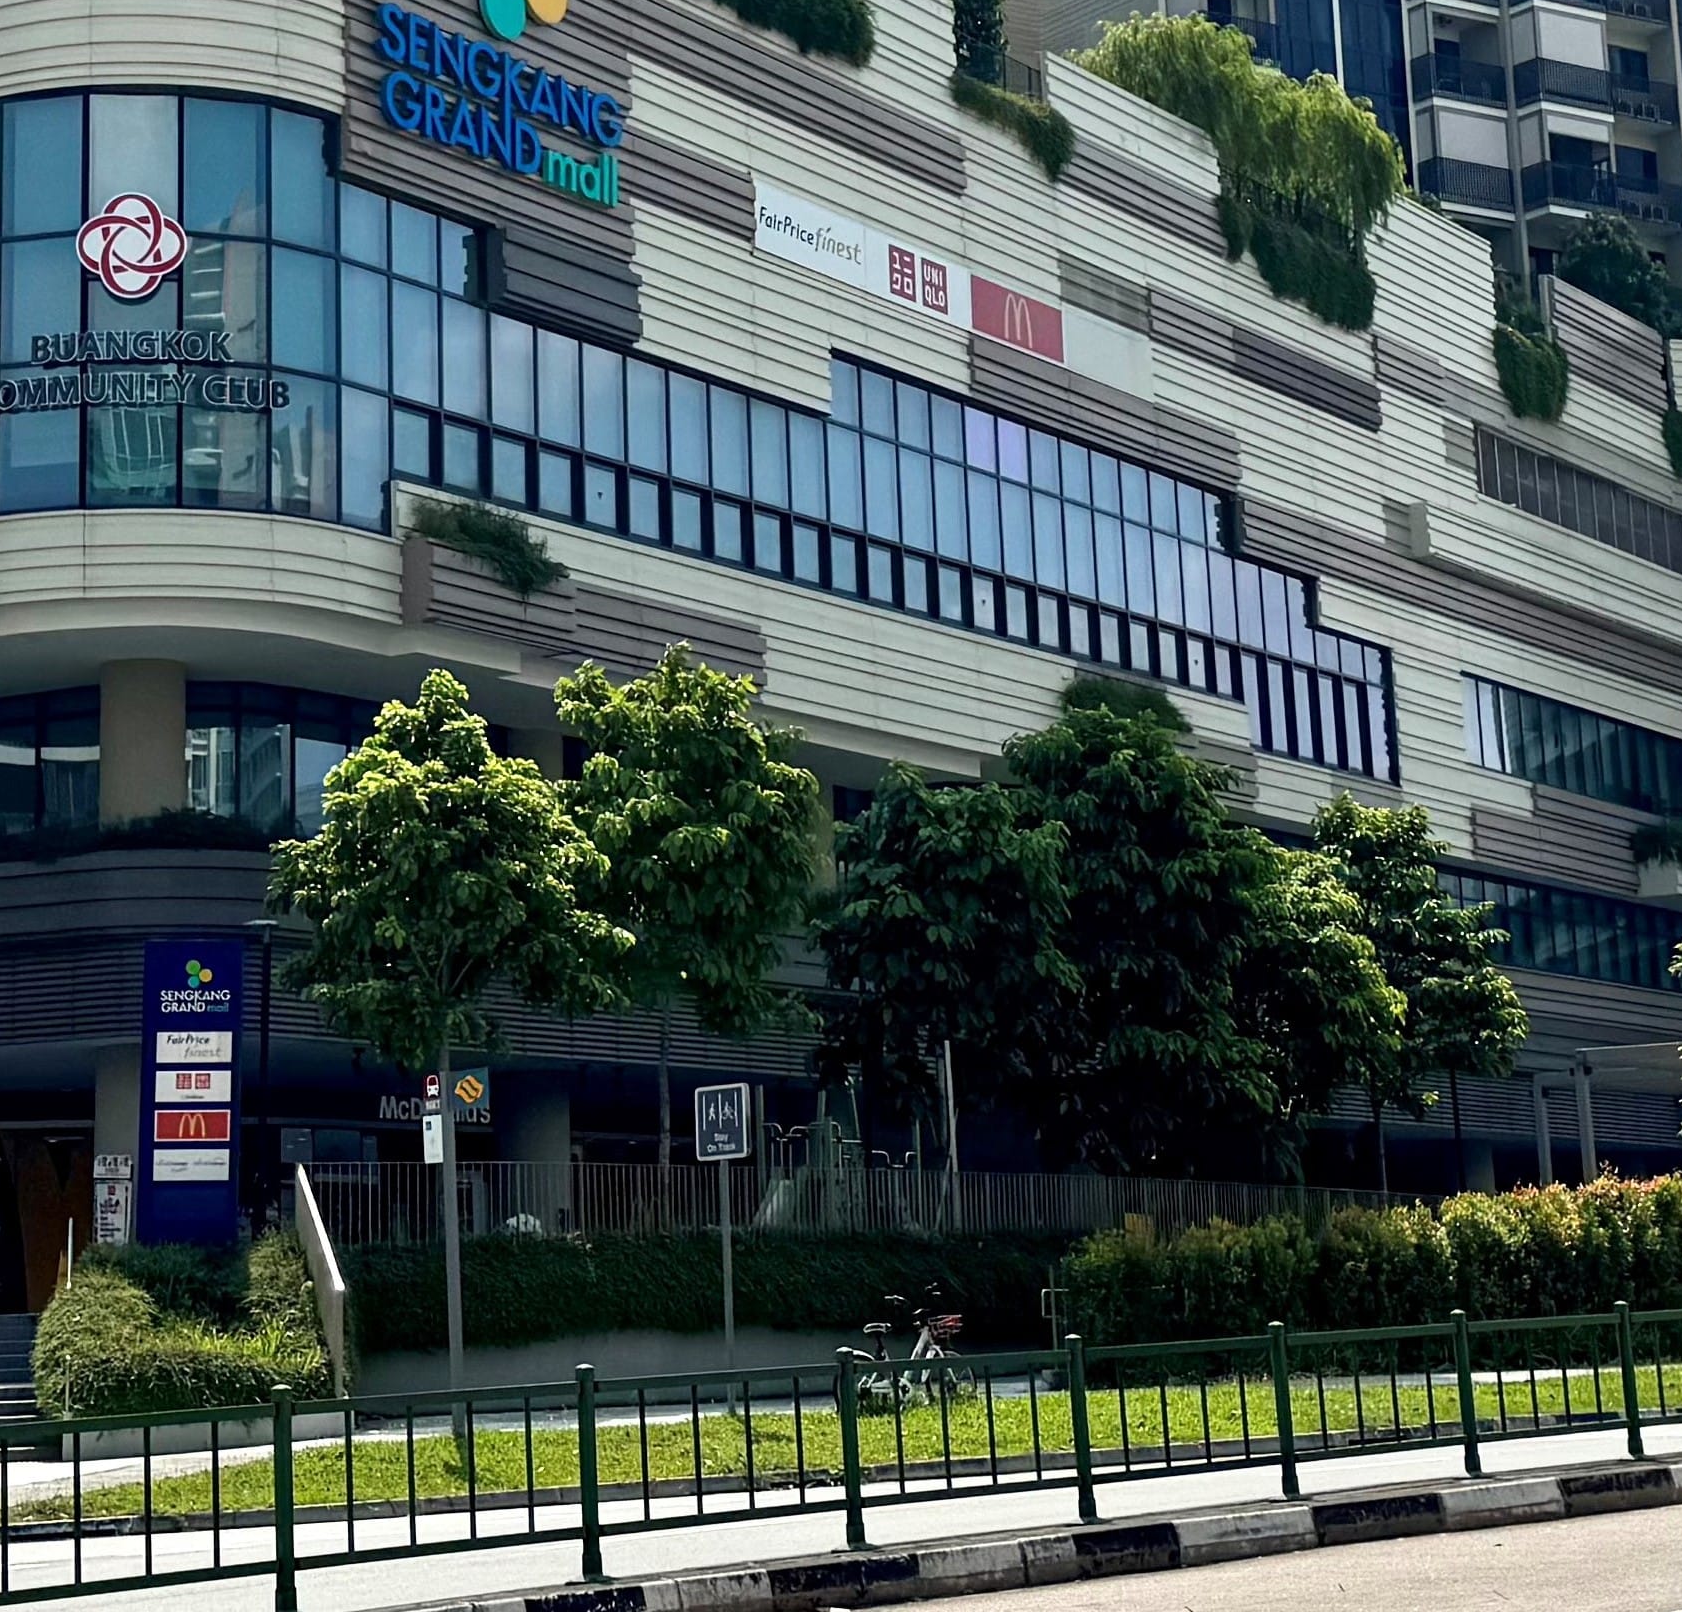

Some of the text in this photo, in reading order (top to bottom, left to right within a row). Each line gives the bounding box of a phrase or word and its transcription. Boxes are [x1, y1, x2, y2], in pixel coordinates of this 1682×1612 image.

[378, 2, 623, 148] SENGKANG
[381, 70, 618, 208] GRAND mall
[30, 330, 235, 366] BUANGKOK
[202, 374, 291, 409] CLUB
[159, 989, 231, 1001] SENGKANG
[161, 1001, 206, 1013] GRAND
